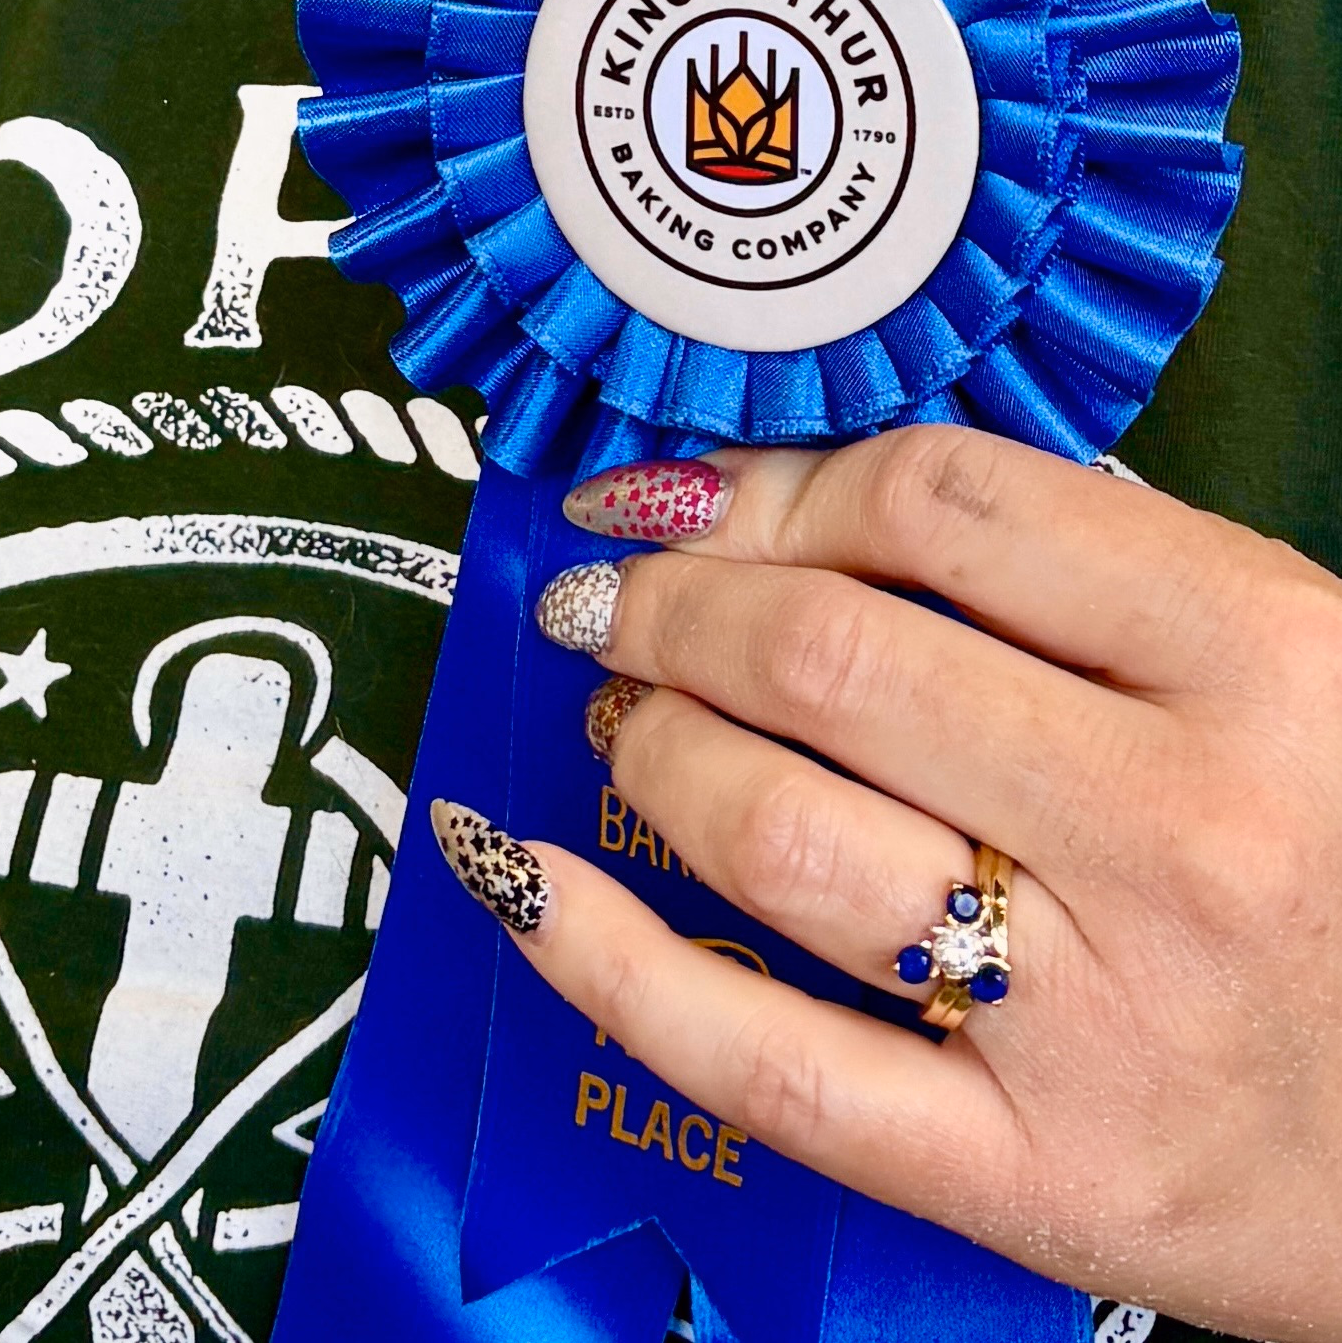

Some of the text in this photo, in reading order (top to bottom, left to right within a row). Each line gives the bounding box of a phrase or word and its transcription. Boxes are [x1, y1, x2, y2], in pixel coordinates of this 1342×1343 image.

[593, 104, 635, 120] ESTD
[853, 129, 896, 144] 1790
[610, 142, 876, 261] BAKING COMPANY
[575, 1071, 749, 1187] PLACE
